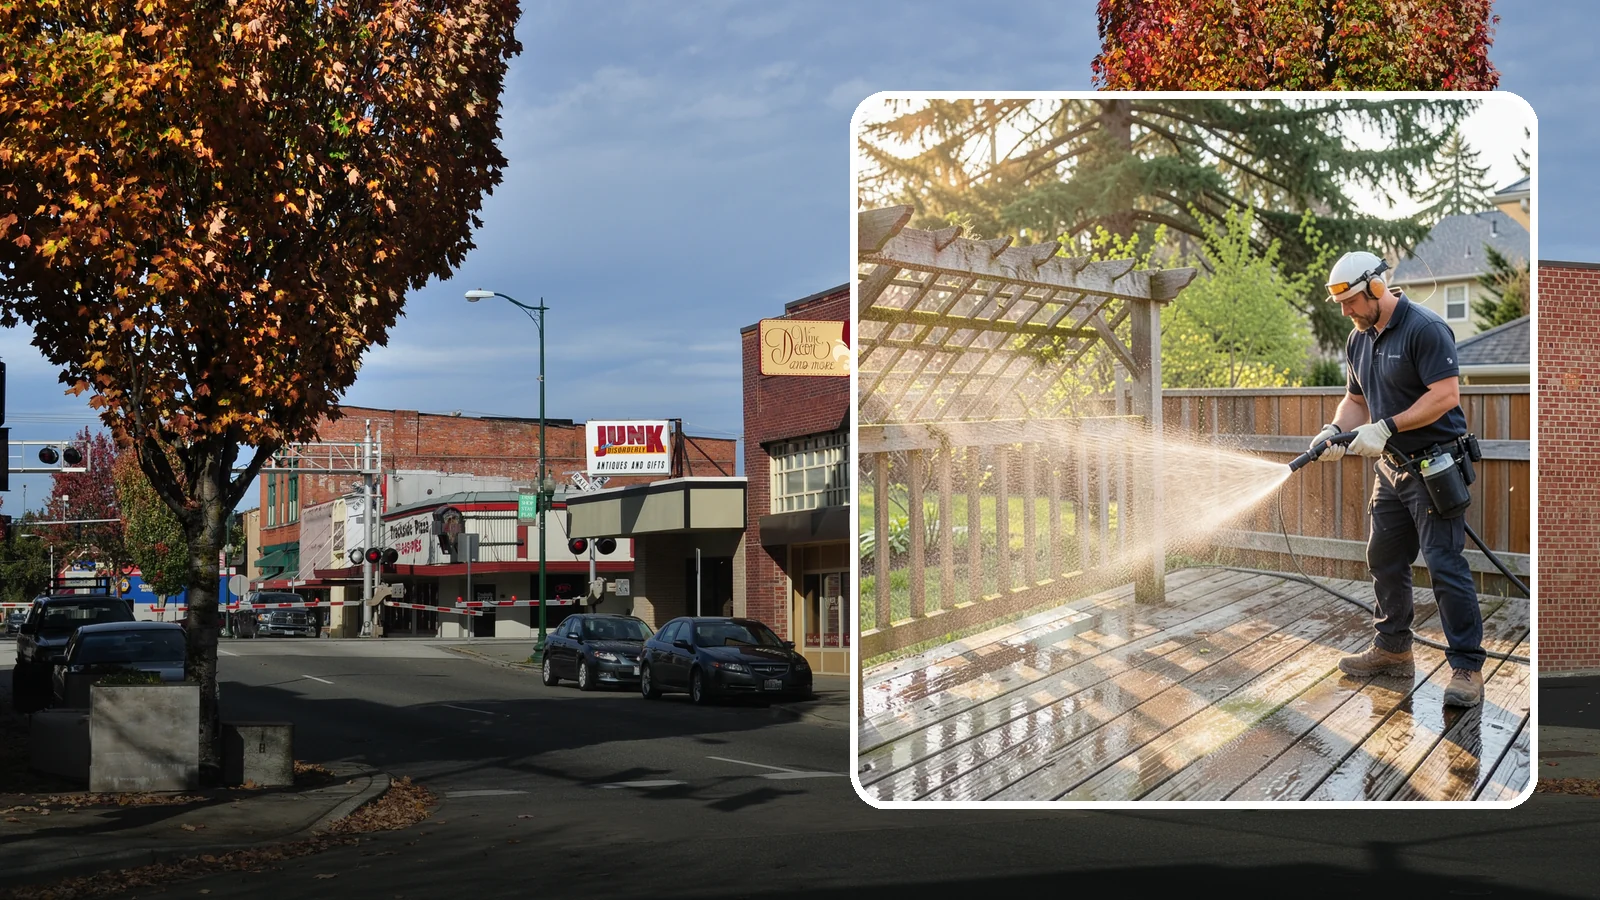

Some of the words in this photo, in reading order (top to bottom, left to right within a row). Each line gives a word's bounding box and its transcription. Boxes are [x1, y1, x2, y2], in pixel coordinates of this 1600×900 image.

[764, 327, 831, 365] Decor
[595, 425, 665, 457] JUNK
[607, 446, 646, 454] DISORDERLY
[596, 461, 628, 470] ANTIQUES
[631, 461, 643, 470] AND
[646, 460, 665, 469] GIFTS
[414, 519, 429, 535] Pizza
